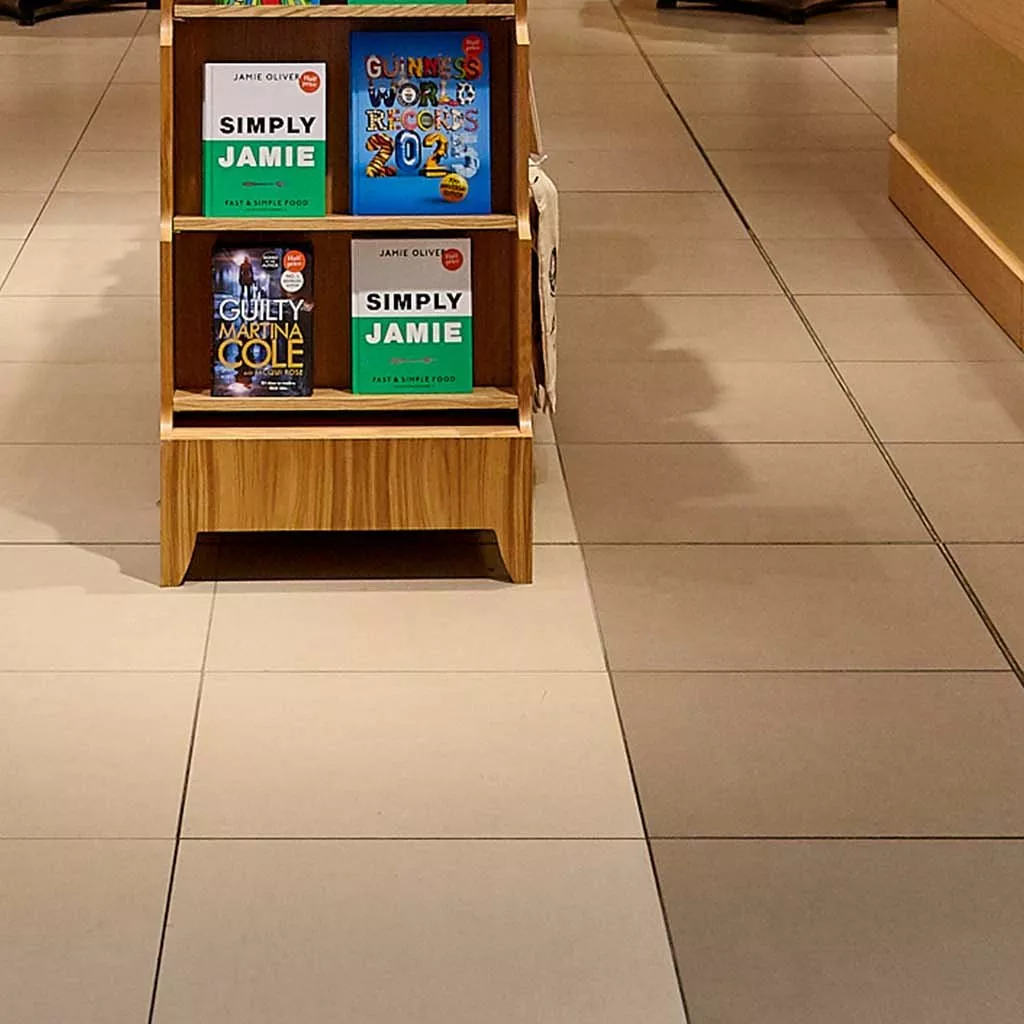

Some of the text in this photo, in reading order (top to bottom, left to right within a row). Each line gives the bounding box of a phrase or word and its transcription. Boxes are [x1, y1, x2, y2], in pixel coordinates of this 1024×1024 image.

[233, 72, 263, 82] JAMIE
[367, 80, 477, 108] WORLD
[219, 116, 316, 134] SIMPLY
[365, 107, 480, 132] RECORDS
[218, 145, 316, 168] JAMIE
[365, 130, 480, 178] 2025
[224, 199, 245, 207] FAST
[252, 199, 282, 207] SIMPLE
[284, 199, 309, 207] FOOD
[379, 248, 408, 257] JAMIE
[219, 298, 305, 321] GUILTY
[366, 292, 463, 311] SIMPLY
[218, 322, 303, 340] MARTINA
[365, 322, 463, 344] JAMIE
[217, 338, 304, 369] COLE
